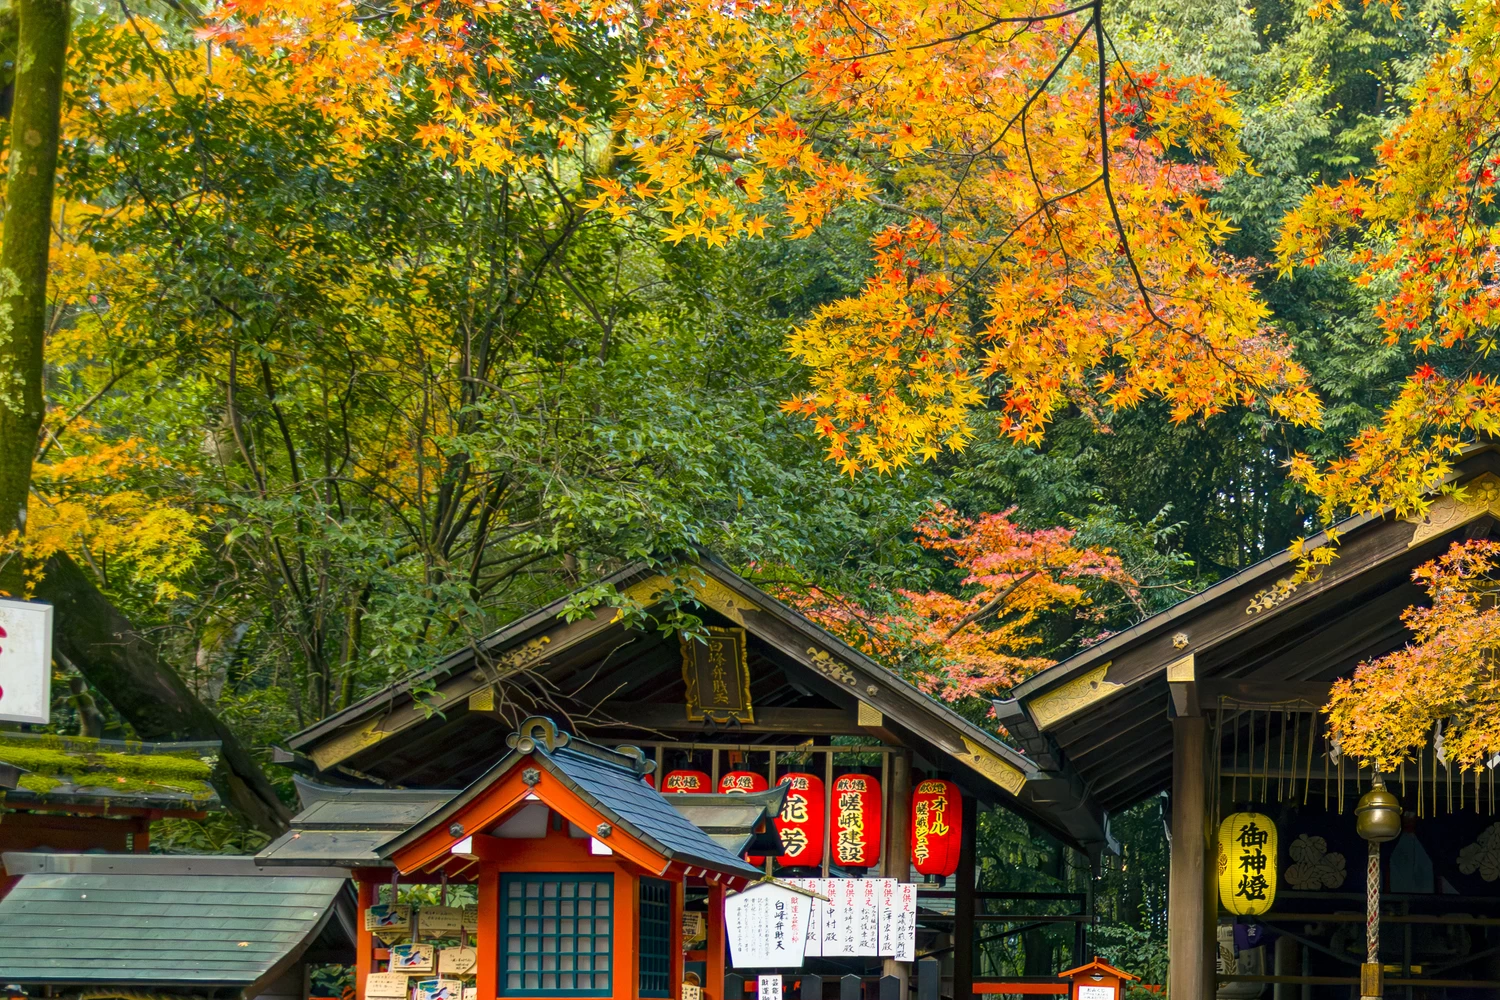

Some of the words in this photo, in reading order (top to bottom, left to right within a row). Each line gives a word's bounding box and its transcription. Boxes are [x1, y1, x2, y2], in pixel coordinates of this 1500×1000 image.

[667, 775, 700, 789] 献燈
[722, 775, 754, 789] 献燈
[837, 779, 866, 792] 献燈
[919, 782, 947, 794] 献燈
[780, 795, 808, 857] 花芳
[838, 793, 863, 862] 嵯峨建設
[930, 796, 948, 836] オール
[915, 801, 929, 865] 嵯峨ジュニア
[1235, 822, 1269, 901] 御神燈
[845, 880, 855, 907] お供え
[864, 880, 874, 906] お供え
[883, 880, 893, 907] お供え
[903, 886, 911, 911] お供え
[774, 899, 785, 950] 白峰弁財天
